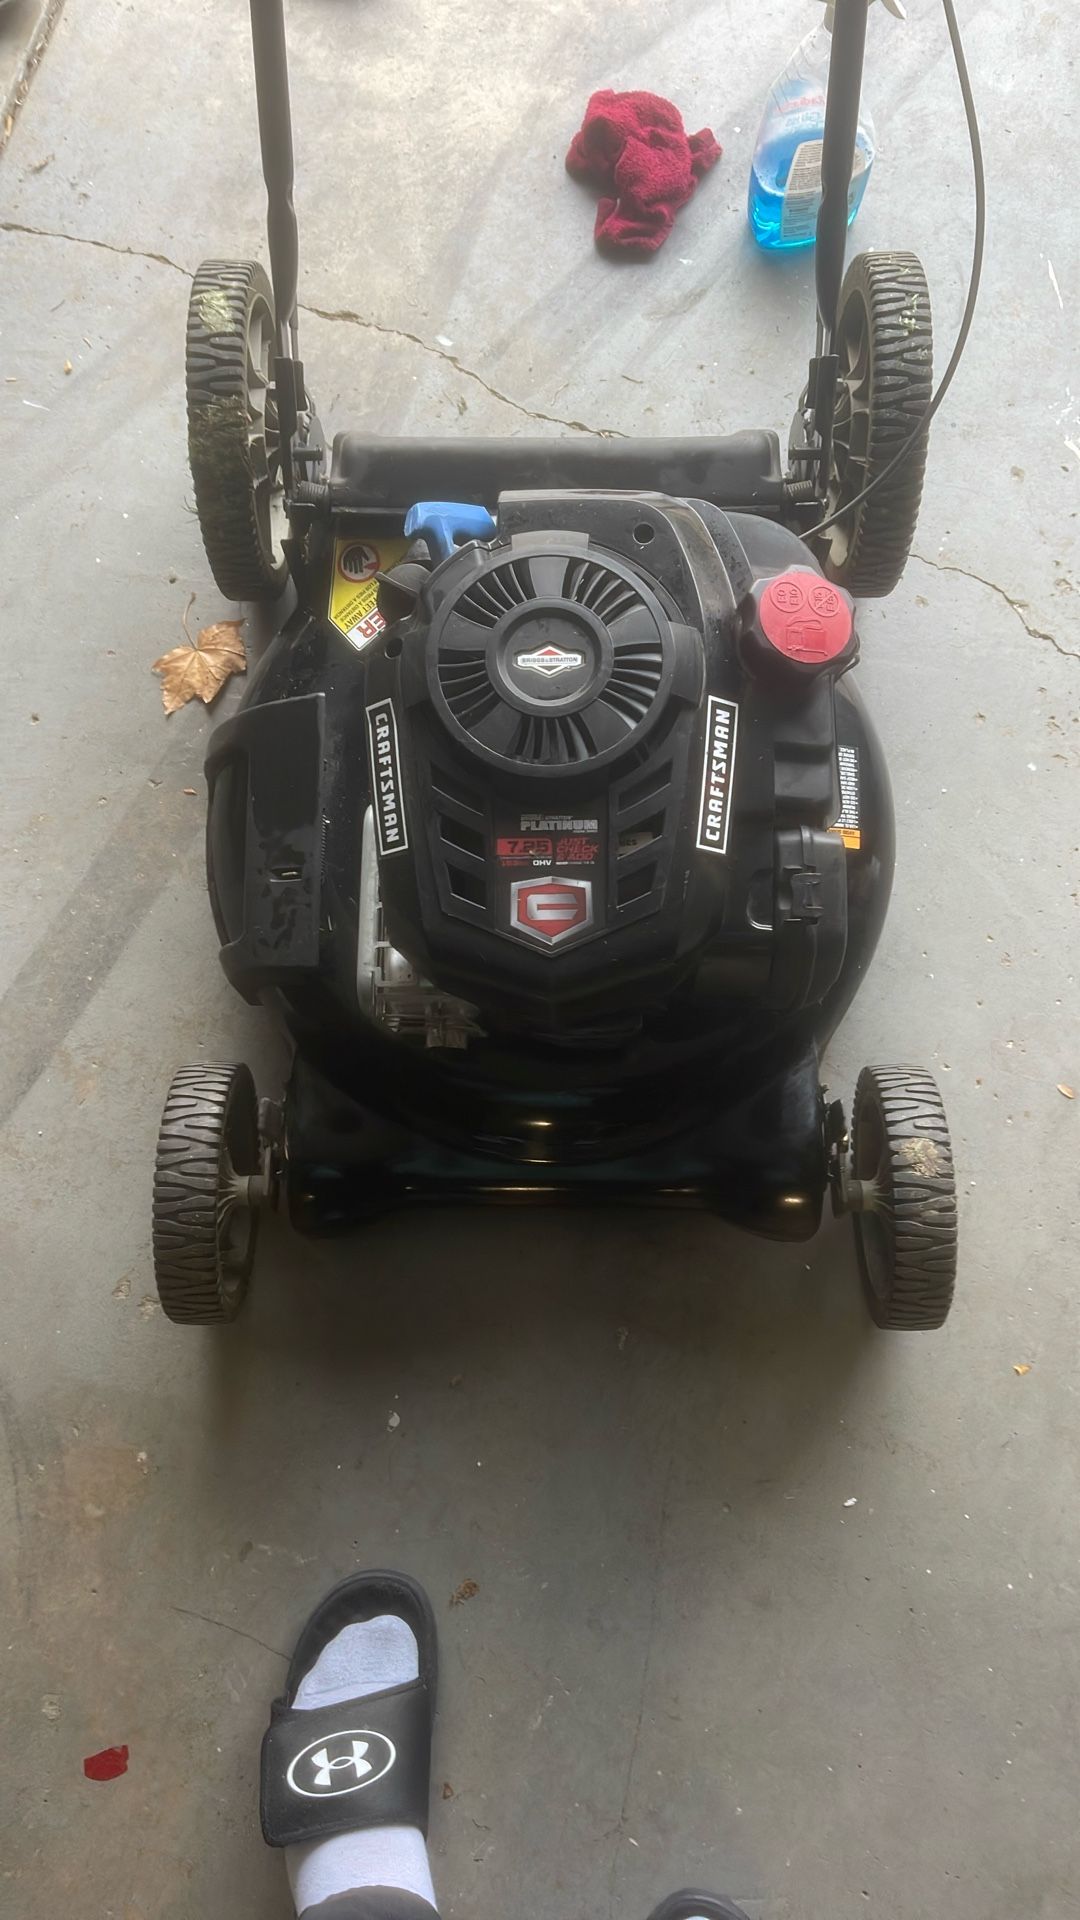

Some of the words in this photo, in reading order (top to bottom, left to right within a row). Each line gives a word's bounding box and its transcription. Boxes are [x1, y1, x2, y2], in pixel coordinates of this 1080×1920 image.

[342, 610, 363, 629] AWAY
[375, 712, 400, 843] CRAFTSMAN
[705, 708, 731, 841] CRAFTSMAN
[520, 819, 598, 831] PLATINUM
